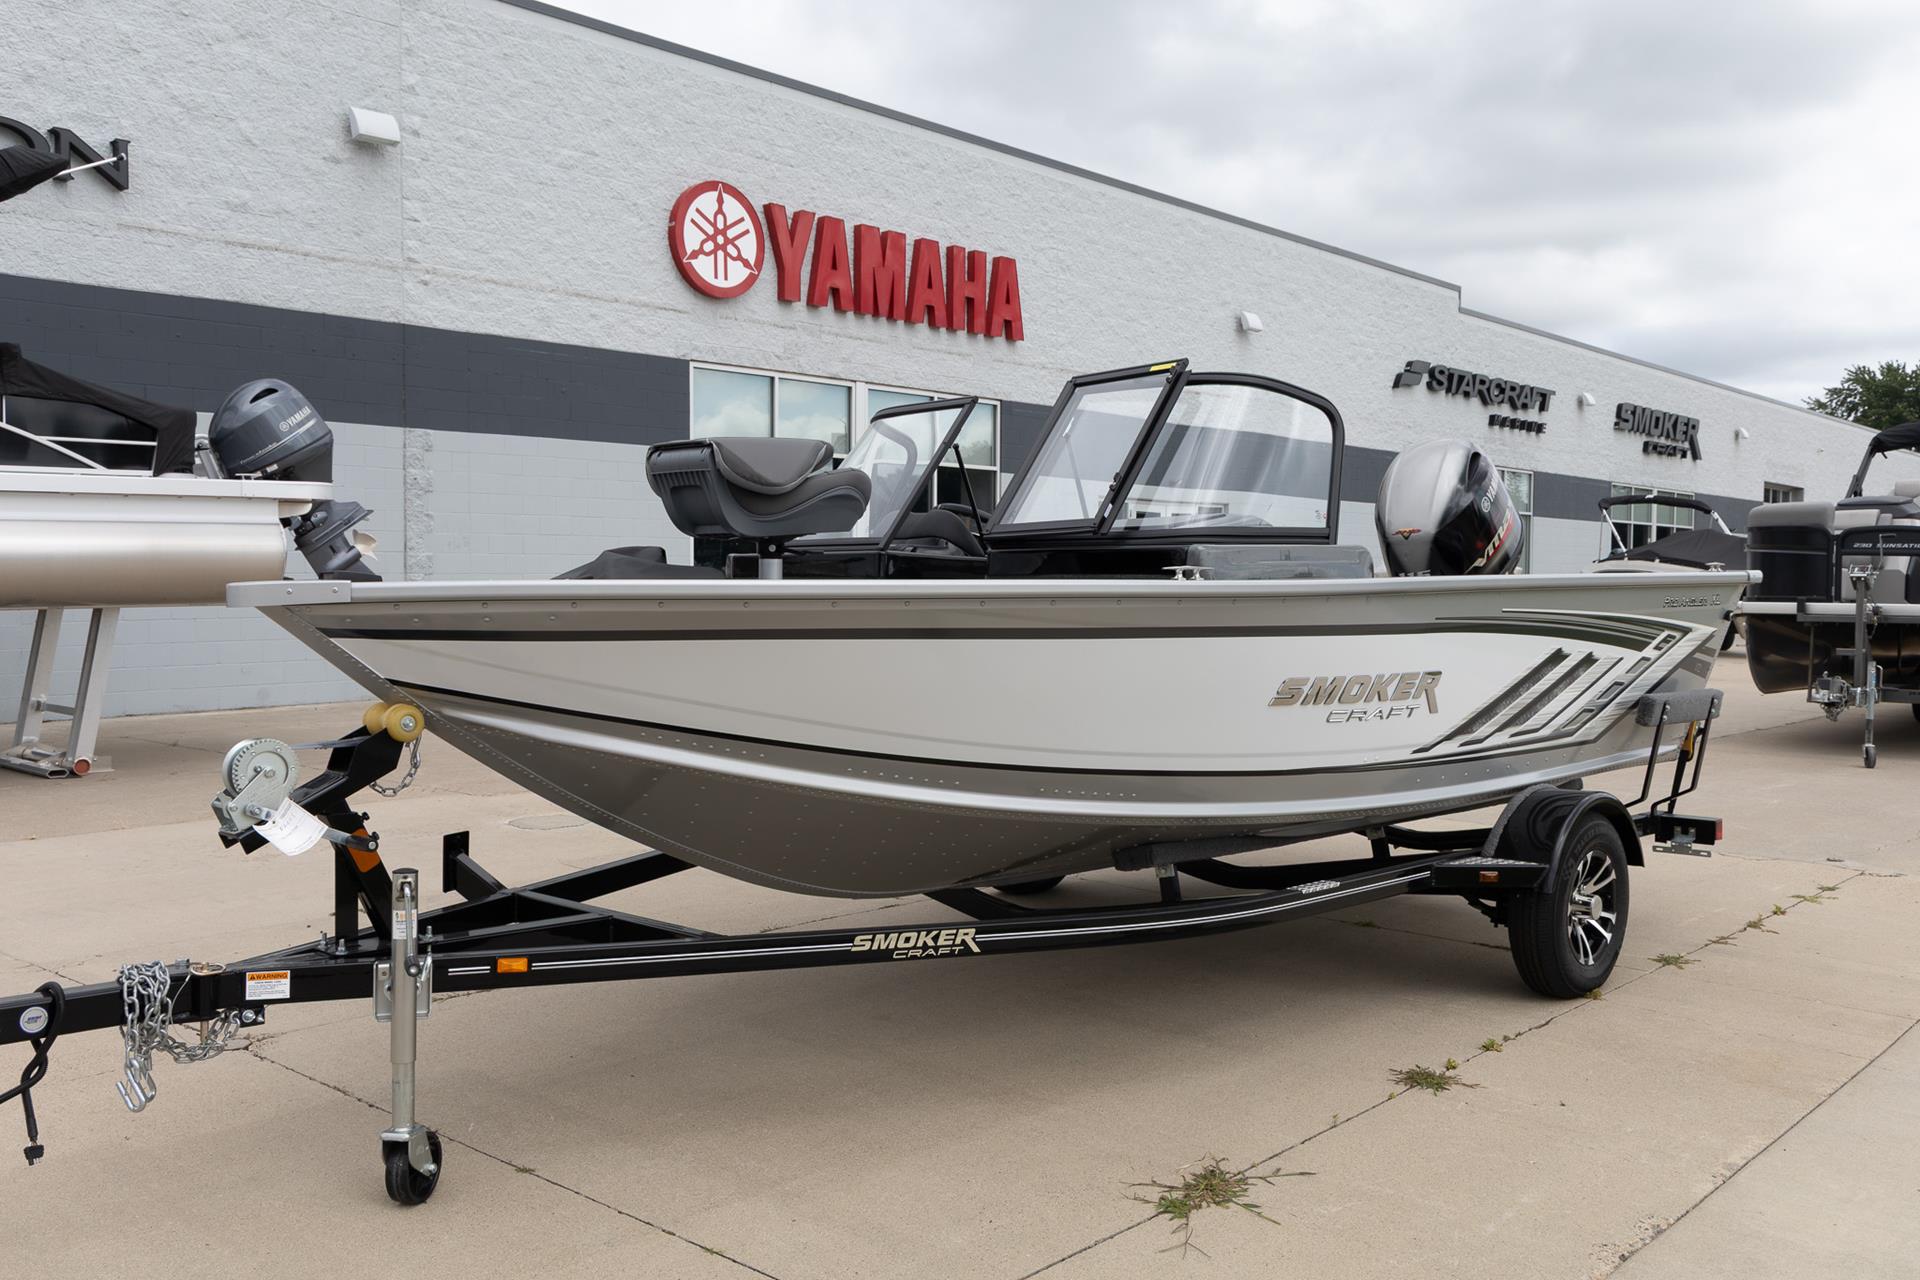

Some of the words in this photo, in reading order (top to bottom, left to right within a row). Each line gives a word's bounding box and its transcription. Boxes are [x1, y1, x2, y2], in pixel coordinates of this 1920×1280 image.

[763, 202, 1024, 341] YAMAHA
[1426, 364, 1557, 412] STARCRAFT
[1613, 402, 1702, 462] SMOKER
[1642, 440, 1692, 459] CRAFT
[1268, 670, 1443, 714] SMOKER
[1326, 704, 1421, 723] CRAFT
[851, 928, 981, 953] SMOKER
[892, 946, 965, 959] CRAFT
[255, 972, 288, 980] WARNING
